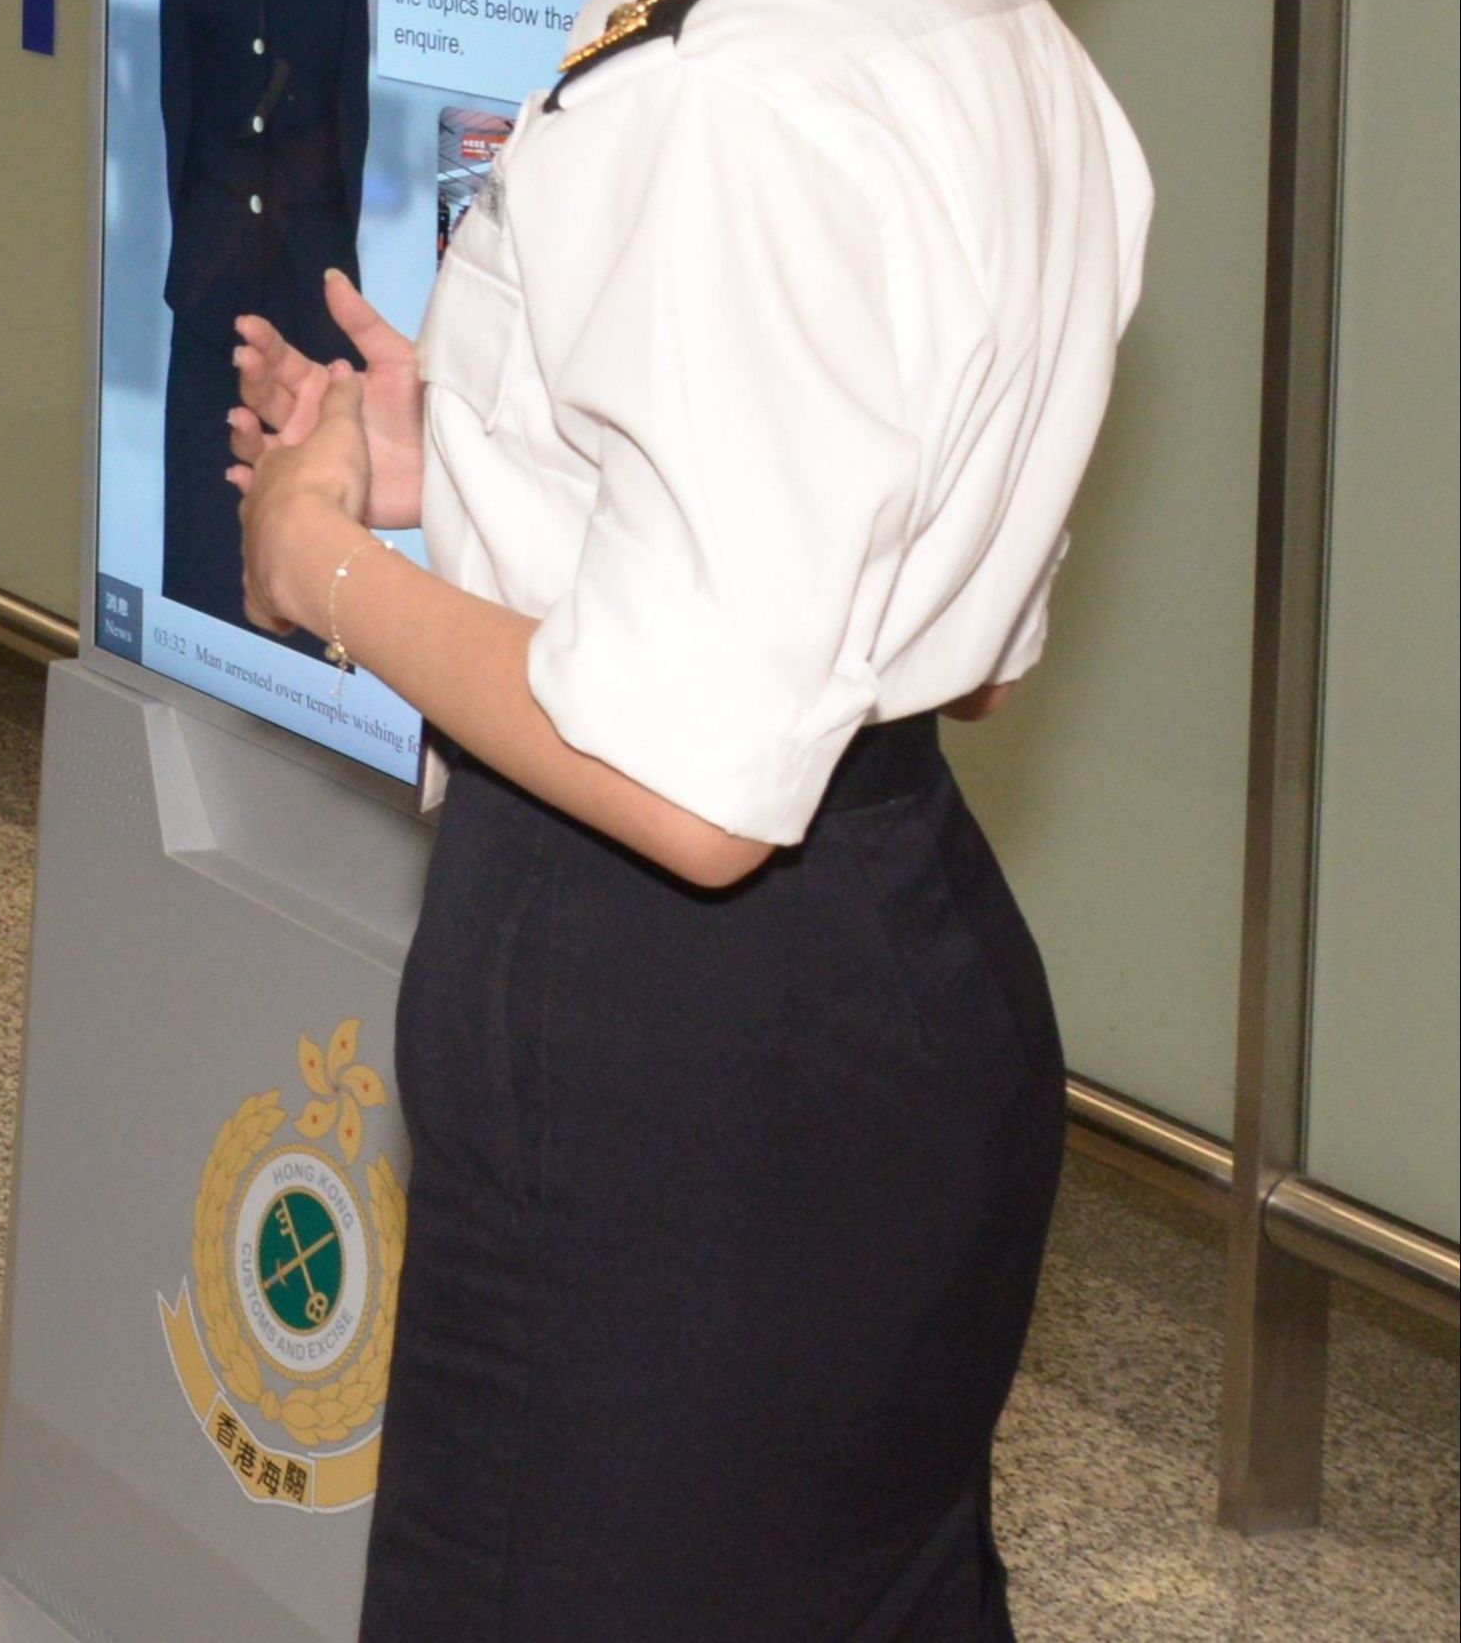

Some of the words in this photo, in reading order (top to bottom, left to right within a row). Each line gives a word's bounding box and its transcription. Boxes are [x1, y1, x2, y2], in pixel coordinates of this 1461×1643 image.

[394, 25, 465, 56] enquire.
[104, 618, 133, 644] News
[195, 643, 222, 672] Man
[224, 660, 273, 694] arrested
[274, 682, 303, 704] over
[306, 693, 350, 725] temple
[351, 714, 405, 753] wishing
[272, 1162, 315, 1185] HONG
[317, 1172, 355, 1231] KONG
[240, 1242, 277, 1344] CUSTOMS
[275, 1336, 307, 1362] AND
[307, 1310, 354, 1360] EXCISE
[216, 1411, 307, 1504] 香港海關
